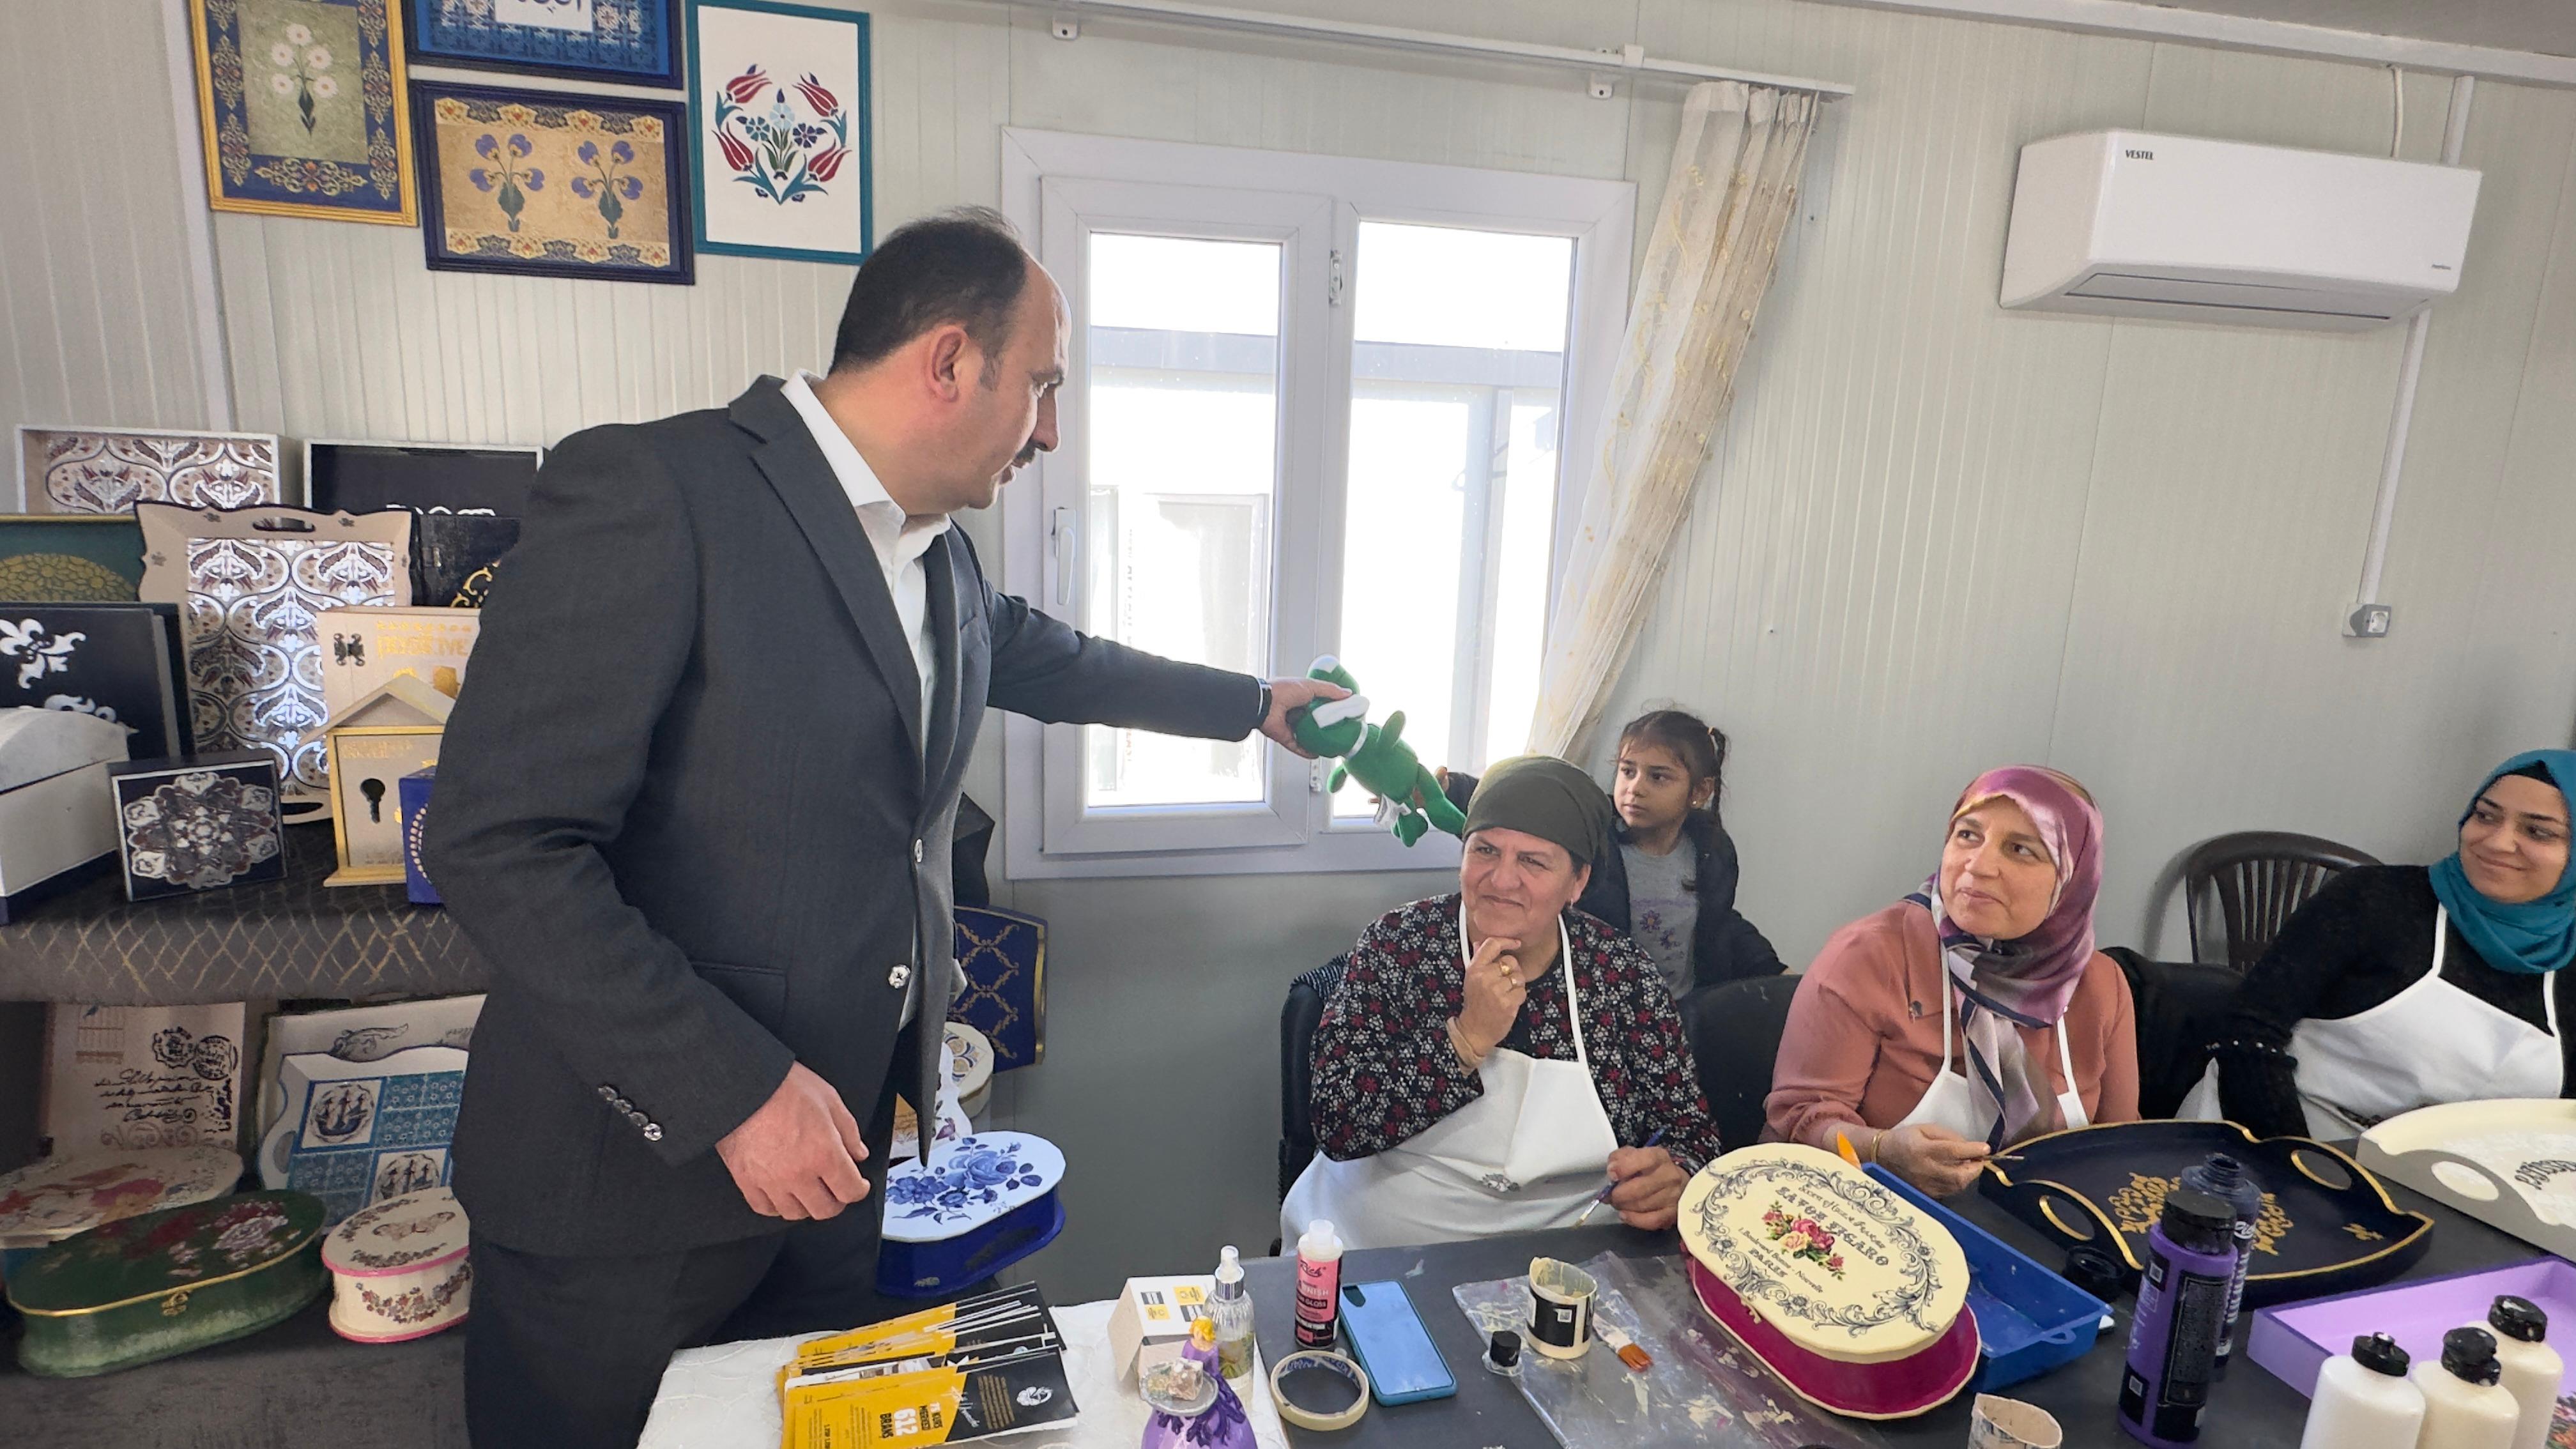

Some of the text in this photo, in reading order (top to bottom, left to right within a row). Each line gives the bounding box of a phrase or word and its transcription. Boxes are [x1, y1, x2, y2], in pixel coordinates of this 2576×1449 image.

[2126, 150, 2154, 160] VESTEL
[1300, 1259, 1322, 1277] Rich
[893, 1407, 918, 1437] 612
